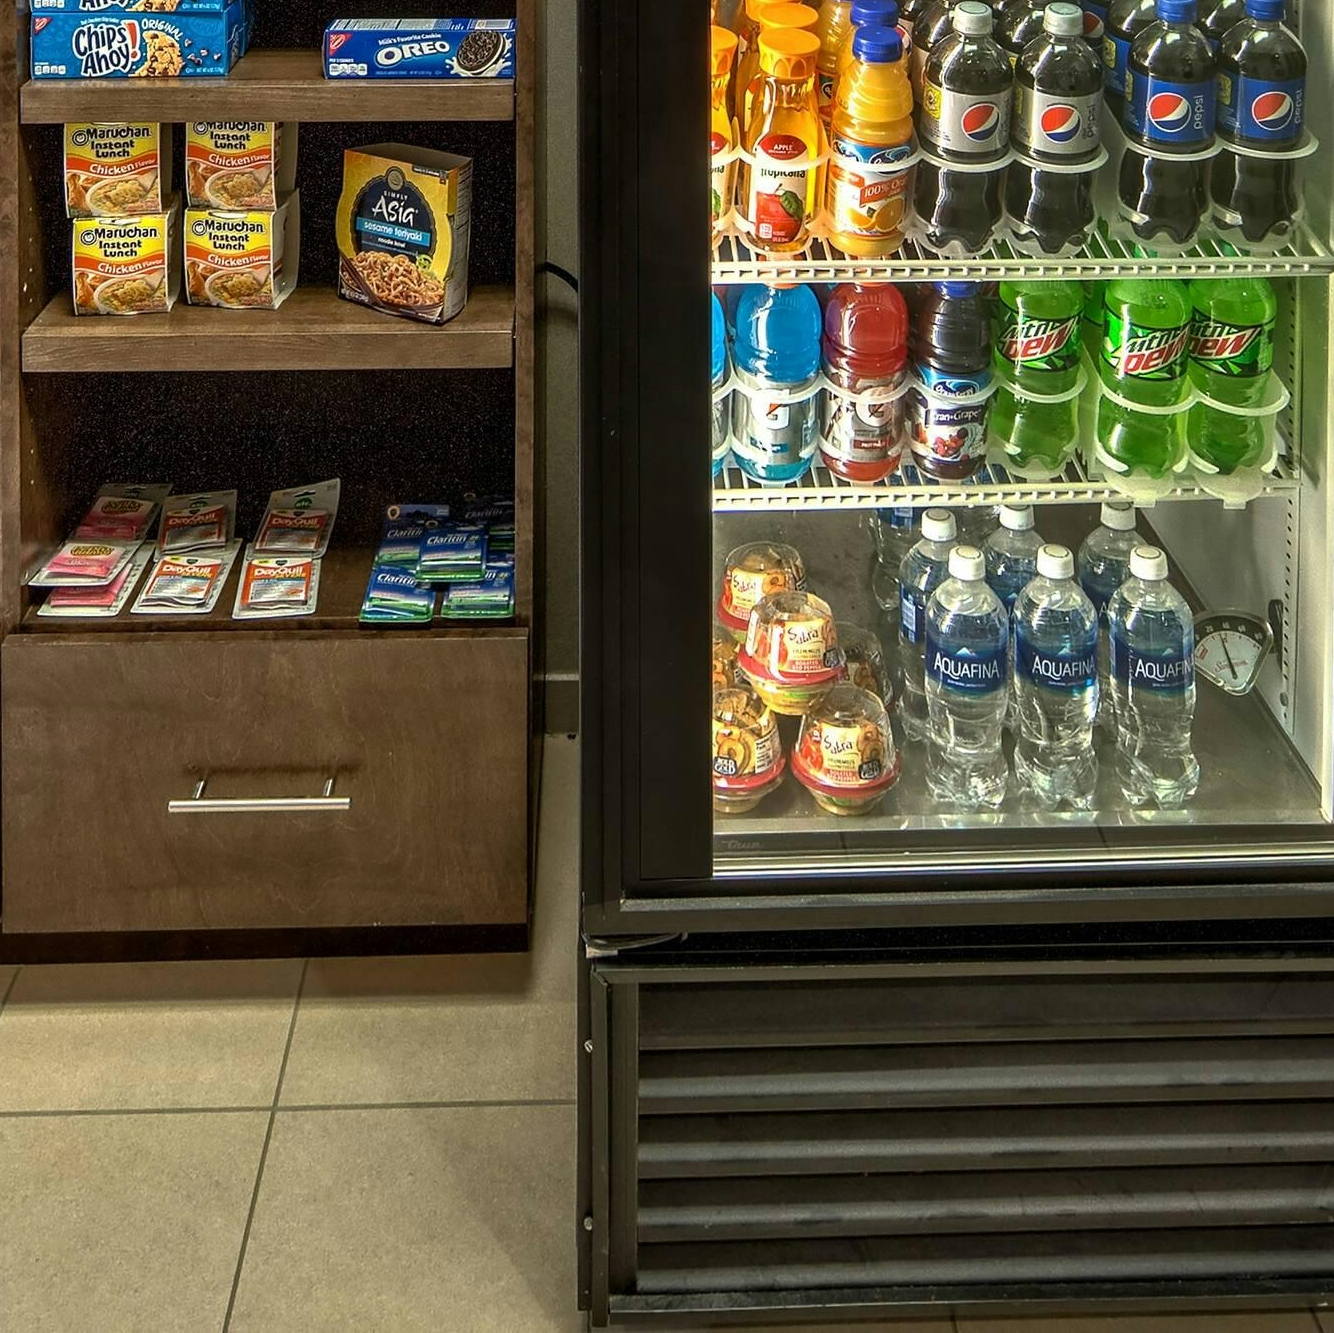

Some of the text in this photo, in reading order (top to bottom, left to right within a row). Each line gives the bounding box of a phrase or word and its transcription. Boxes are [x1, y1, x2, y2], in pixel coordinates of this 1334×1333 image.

[141, 19, 184, 41] ORIGINAL
[74, 24, 127, 56] Chips
[396, 35, 421, 43] Favorite
[376, 41, 450, 66] OREO
[1192, 94, 1204, 131] pepsi
[1294, 89, 1304, 124] pepsi
[86, 127, 150, 139] Maruchan
[208, 122, 265, 132] Maruchan
[211, 132, 250, 141] Instant
[91, 140, 134, 150] Instant
[214, 141, 246, 150] Lunch
[773, 143, 793, 151] APPLE
[96, 149, 130, 158] Lunch
[208, 154, 270, 166] Chicken Flavor
[90, 159, 155, 175] Chicken Flavor
[384, 190, 408, 201] SIMPLY
[864, 183, 890, 197] 100%
[372, 196, 416, 227] Asia
[205, 221, 263, 232] Maruchan
[364, 222, 423, 241] sesame teriyaki
[95, 227, 157, 239] Maruchan
[209, 233, 249, 242] Instant
[99, 240, 141, 249] Instant
[213, 241, 244, 250] Lunch
[104, 249, 137, 257] Lunch
[207, 255, 269, 266] Chicken Flavor
[98, 259, 163, 275] Chicken Flavor
[169, 513, 216, 526] DayQuil
[271, 517, 318, 527] DayQuil
[427, 534, 467, 546] Claritin
[162, 566, 211, 575] DayQuil
[254, 567, 303, 577] DayQuil
[933, 651, 1001, 679] AQUAFINA
[1032, 655, 1097, 680] AQUAFINA
[823, 735, 853, 755] Sabra
